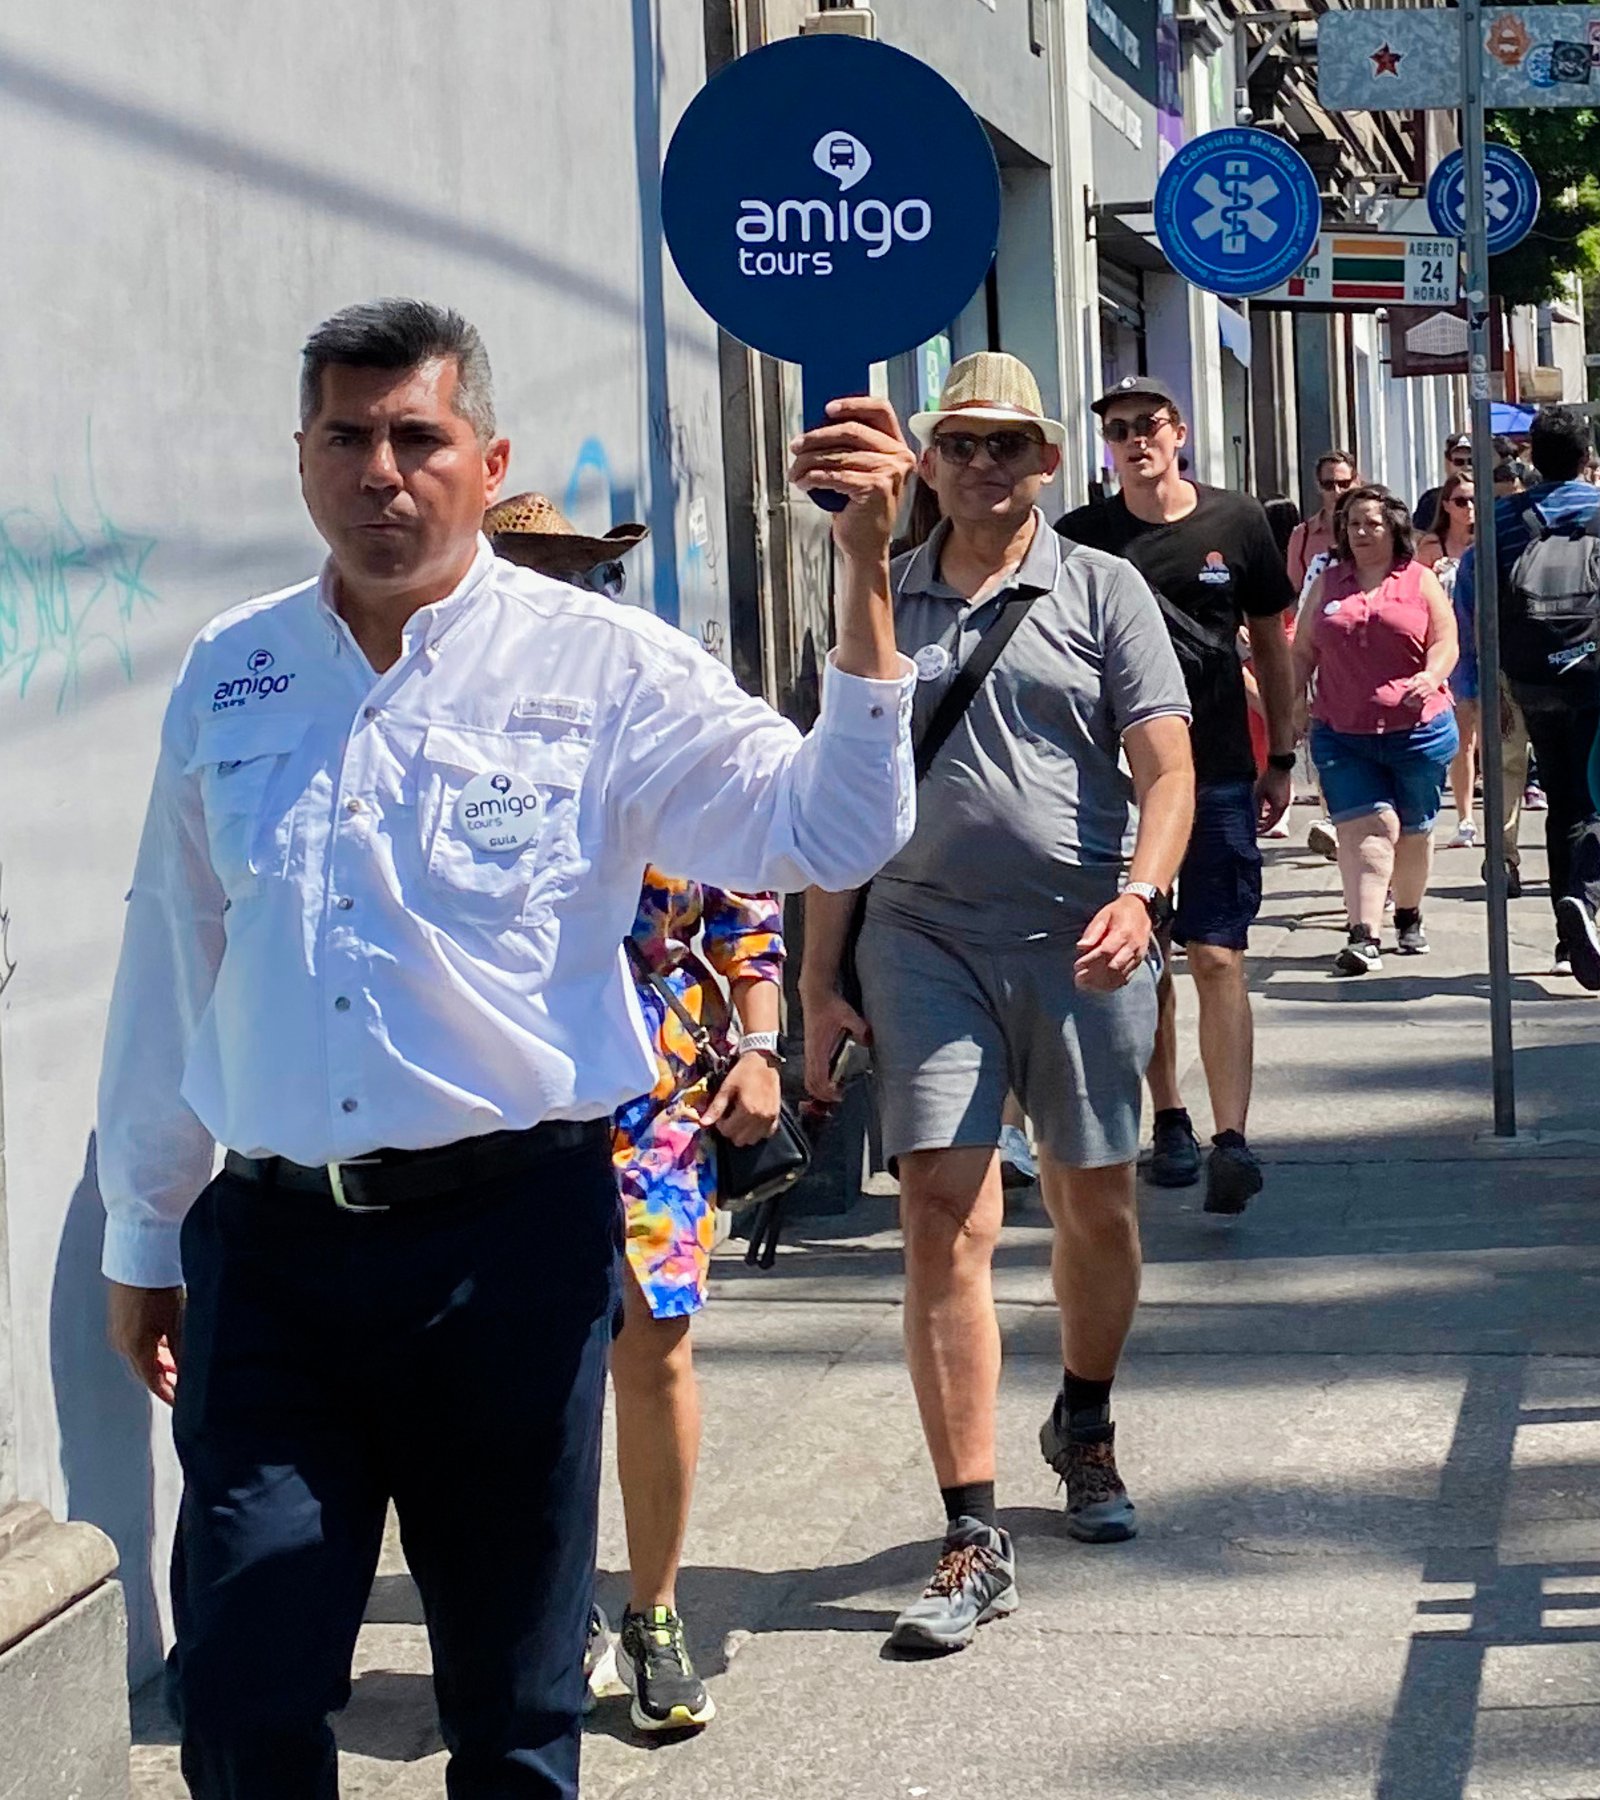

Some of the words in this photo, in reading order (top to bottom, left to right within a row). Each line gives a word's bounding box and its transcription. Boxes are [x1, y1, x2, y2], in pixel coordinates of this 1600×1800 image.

[1180, 134, 1244, 167] Consulta
[736, 199, 932, 258] amigo
[739, 247, 833, 275] tours
[1408, 242, 1454, 257] ABIERTO
[1421, 260, 1444, 283] 24
[1413, 286, 1450, 301] HORAS
[465, 794, 537, 818] amigo
[467, 817, 503, 831] tours
